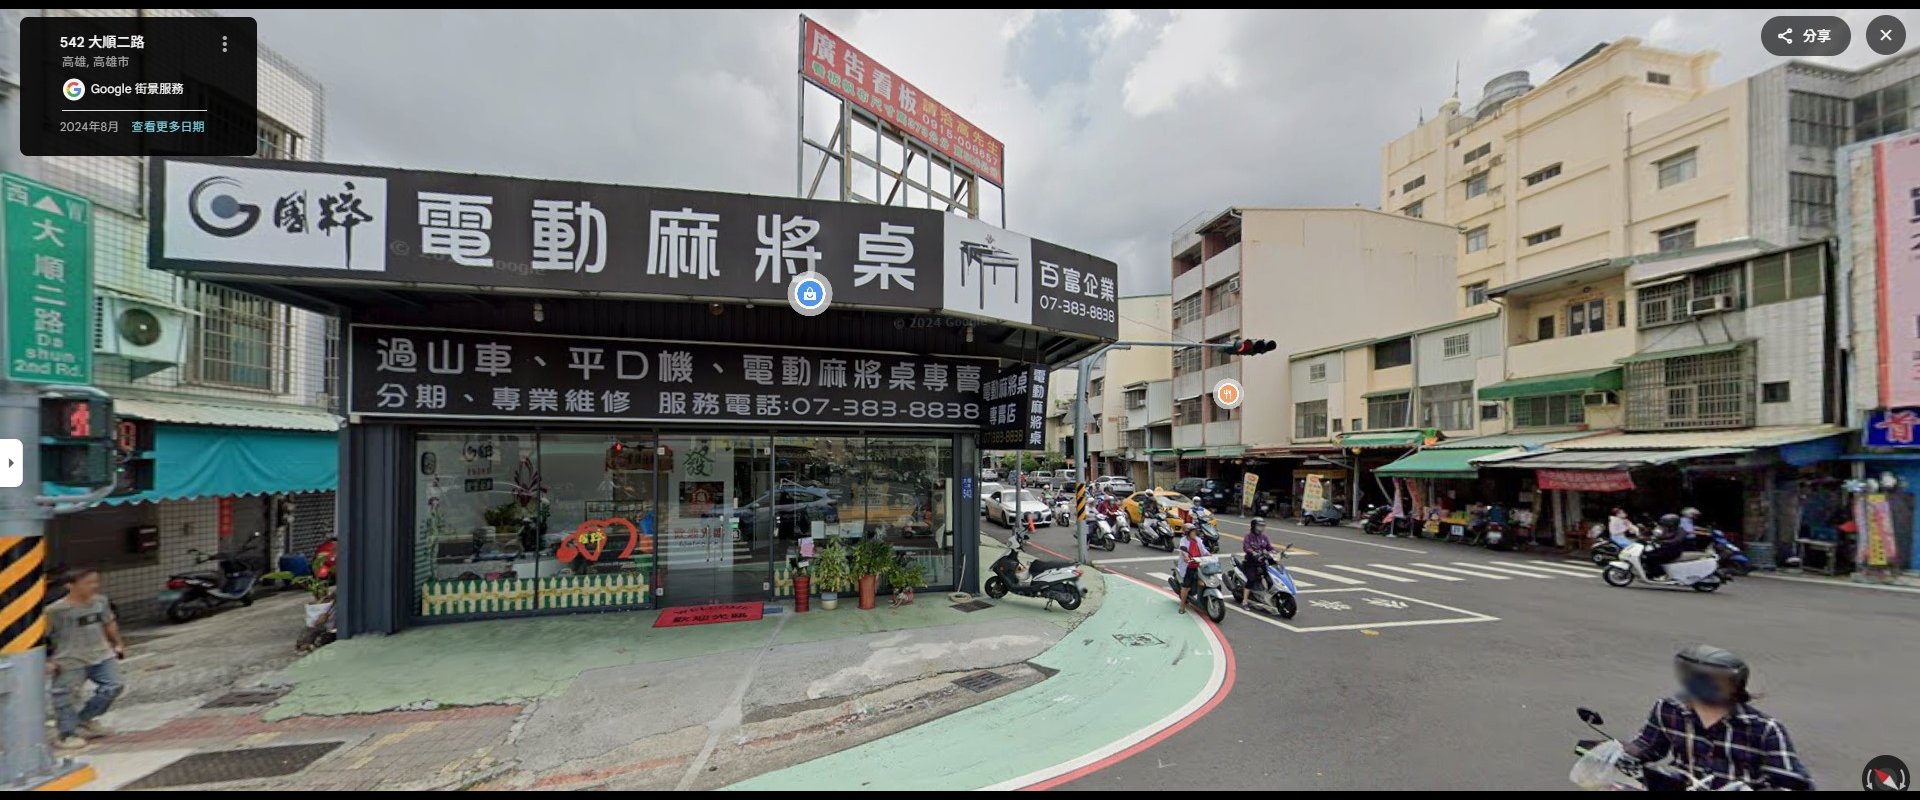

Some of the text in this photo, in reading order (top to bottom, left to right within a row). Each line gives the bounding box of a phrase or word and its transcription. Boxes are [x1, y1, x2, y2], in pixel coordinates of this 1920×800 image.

[812, 29, 917, 116] 廣告看板
[6, 181, 30, 207] 西
[274, 181, 374, 270] 國粹
[417, 191, 916, 291] 電動麻將桌
[31, 218, 67, 334] 大順二路
[1039, 259, 1115, 303] 百富企業
[1039, 295, 1115, 323] 07-383-8838
[14, 359, 84, 378] 2nd Rd.
[376, 383, 631, 413] 分期、專業維修
[983, 370, 1028, 402] 電動麻將桌
[989, 402, 1017, 426] 專賣店
[1029, 368, 1047, 445] 電動麻將桌
[682, 447, 715, 477] 發
